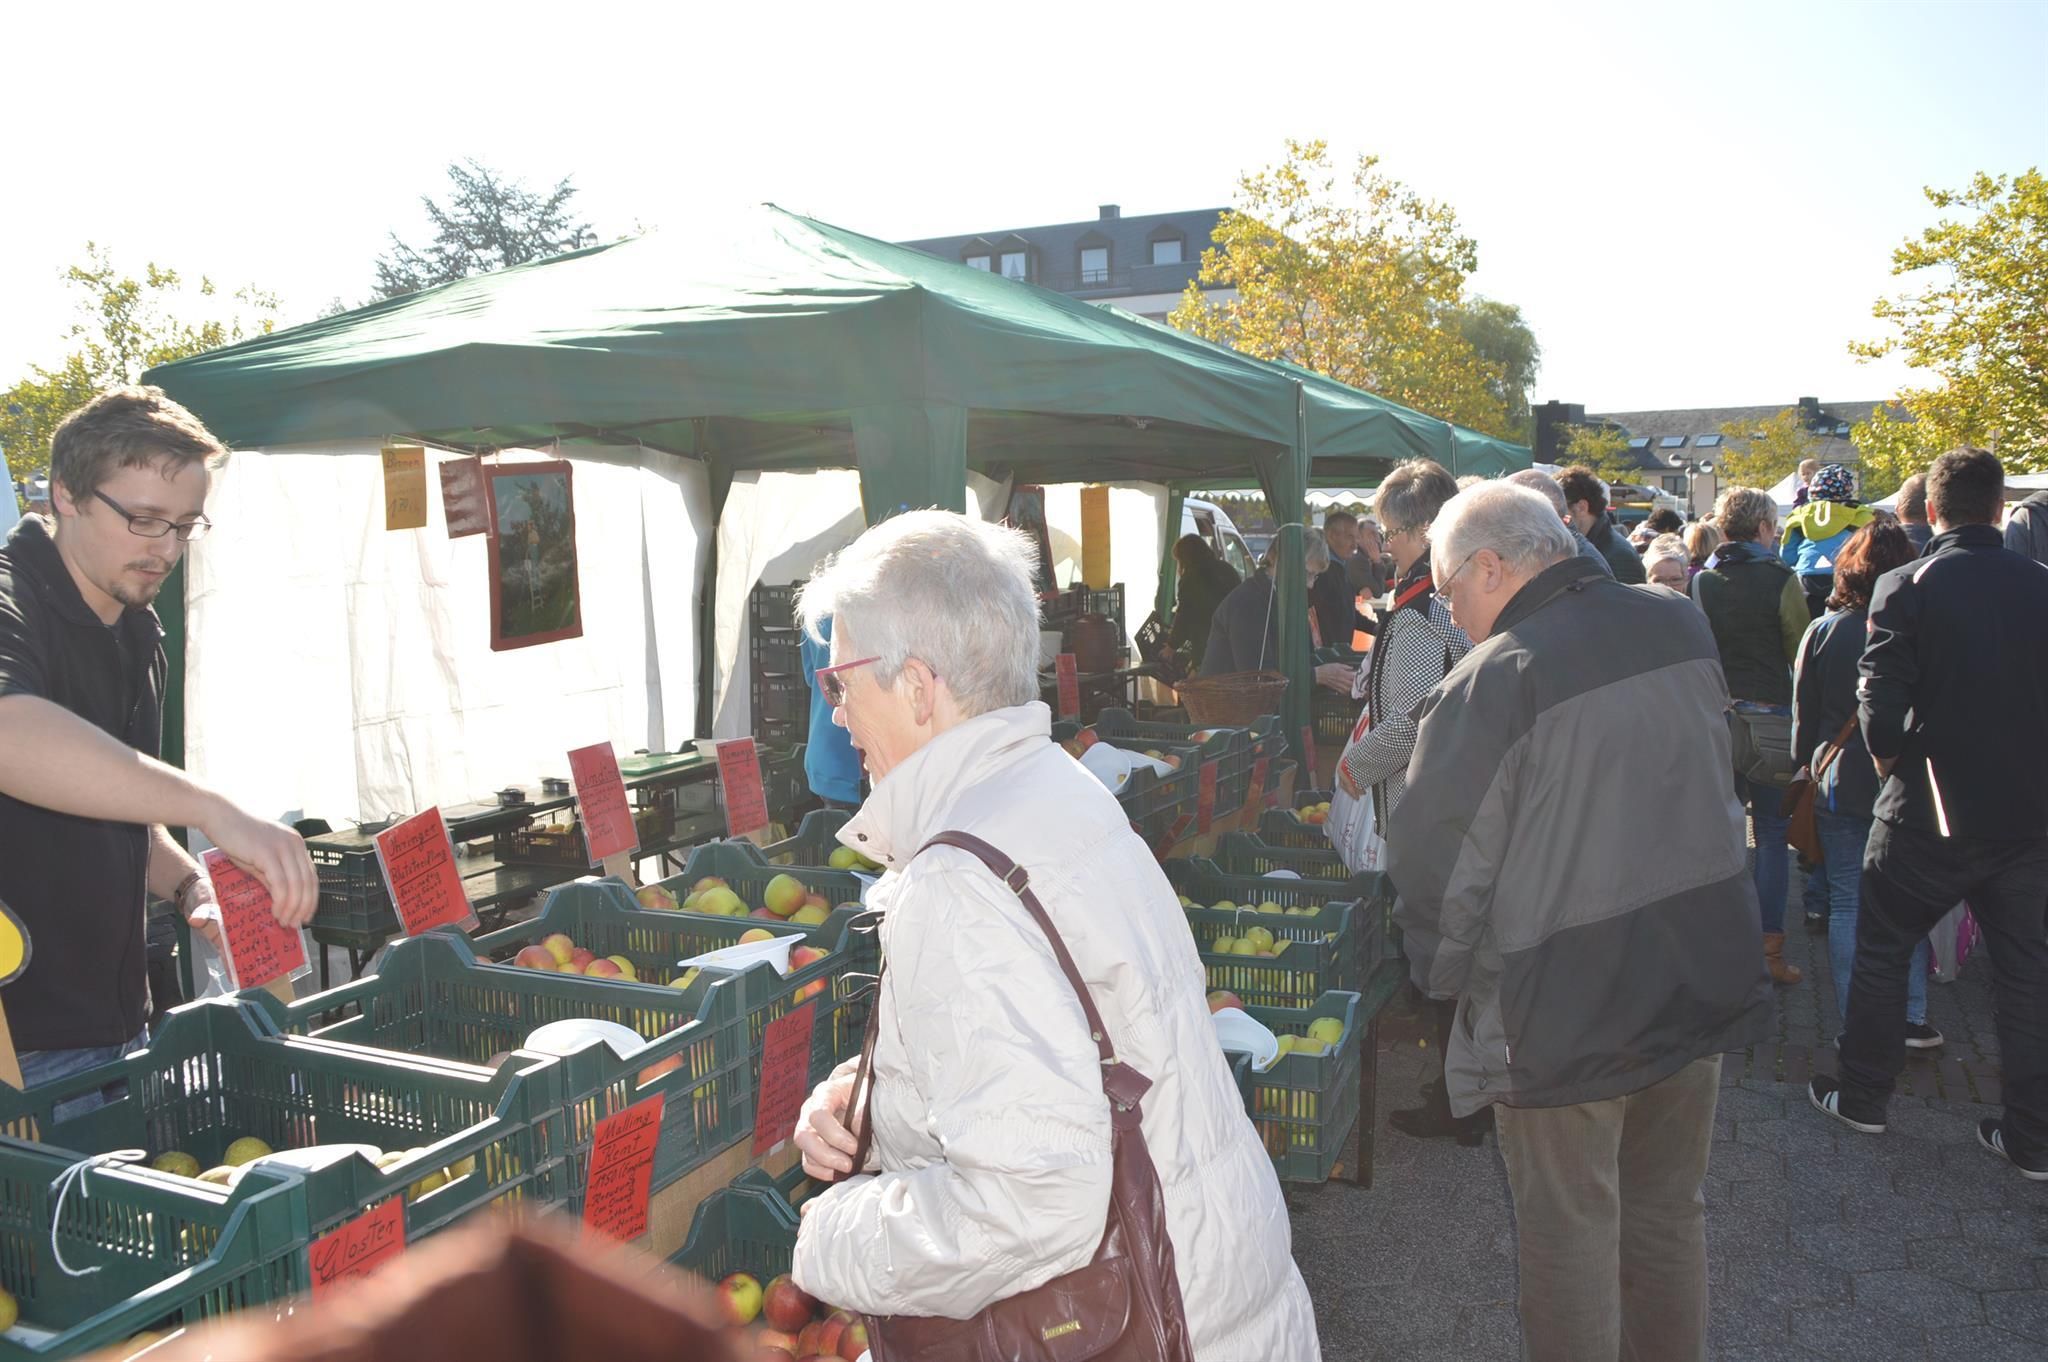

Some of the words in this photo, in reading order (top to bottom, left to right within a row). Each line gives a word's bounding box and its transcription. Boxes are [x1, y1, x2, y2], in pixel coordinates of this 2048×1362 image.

[598, 1111, 651, 1144] Malling
[599, 1134, 642, 1168] Kent
[314, 1214, 397, 1283] Gloster
